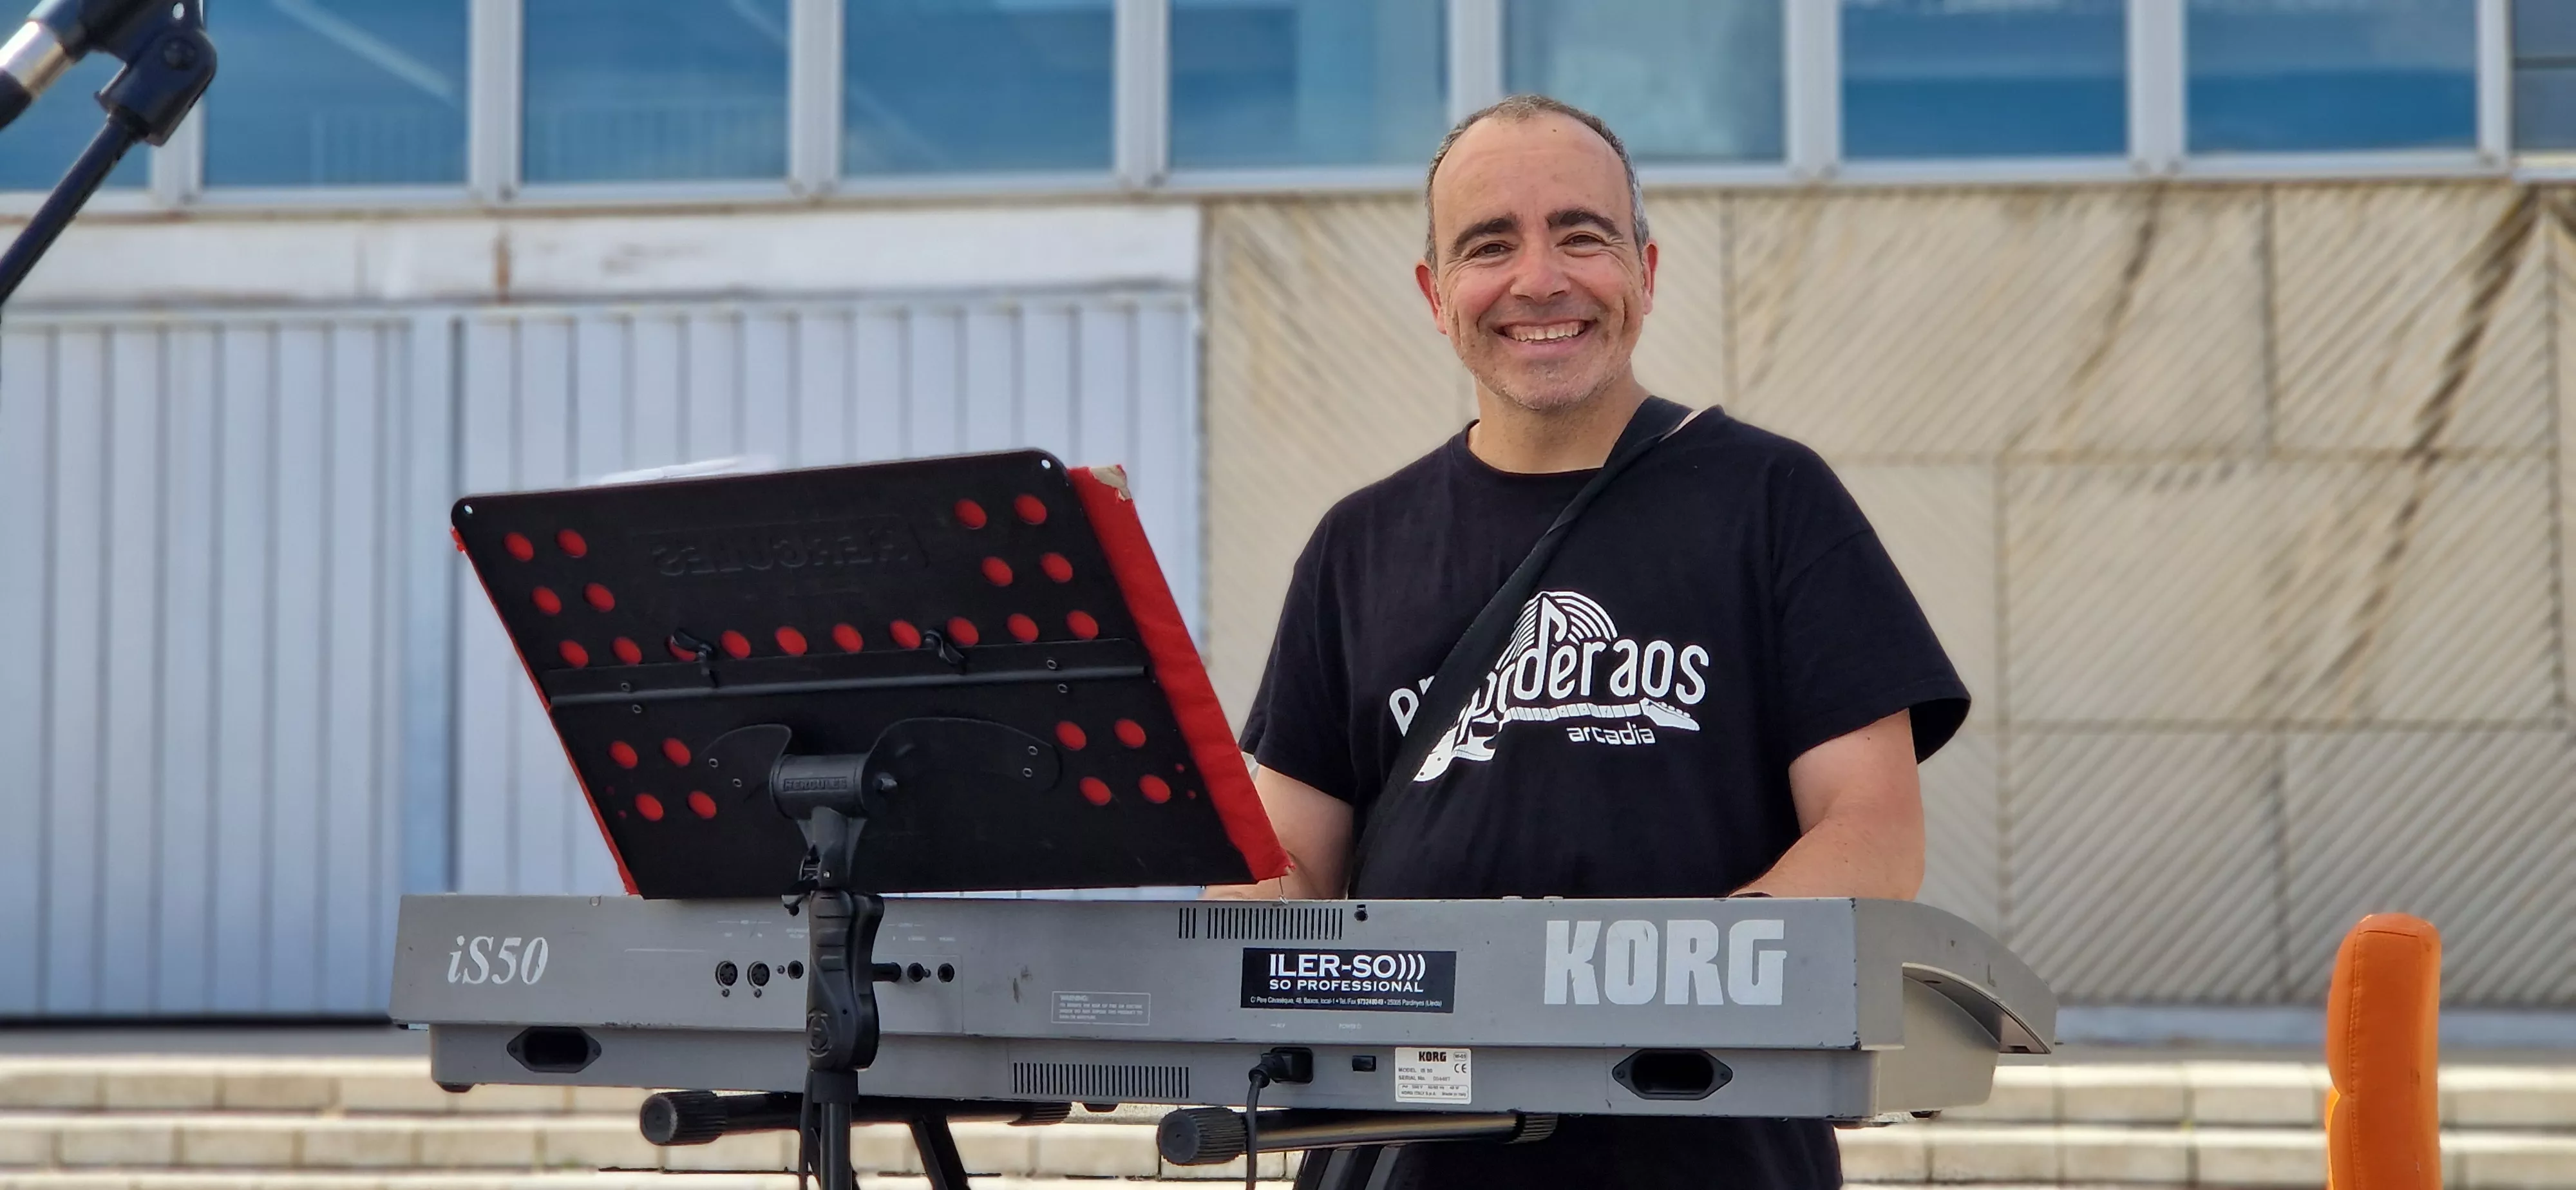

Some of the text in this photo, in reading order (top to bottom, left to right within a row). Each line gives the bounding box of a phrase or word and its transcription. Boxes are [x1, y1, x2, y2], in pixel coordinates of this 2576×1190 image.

[1566, 723, 1656, 746] arcadia
[446, 936, 549, 985] iS50
[1544, 919, 1787, 1005] KORG
[1269, 979, 1424, 993] SO PROFESSIONAL
[1418, 1051, 1446, 1062] KORG
[1454, 1063, 1466, 1073] CE
